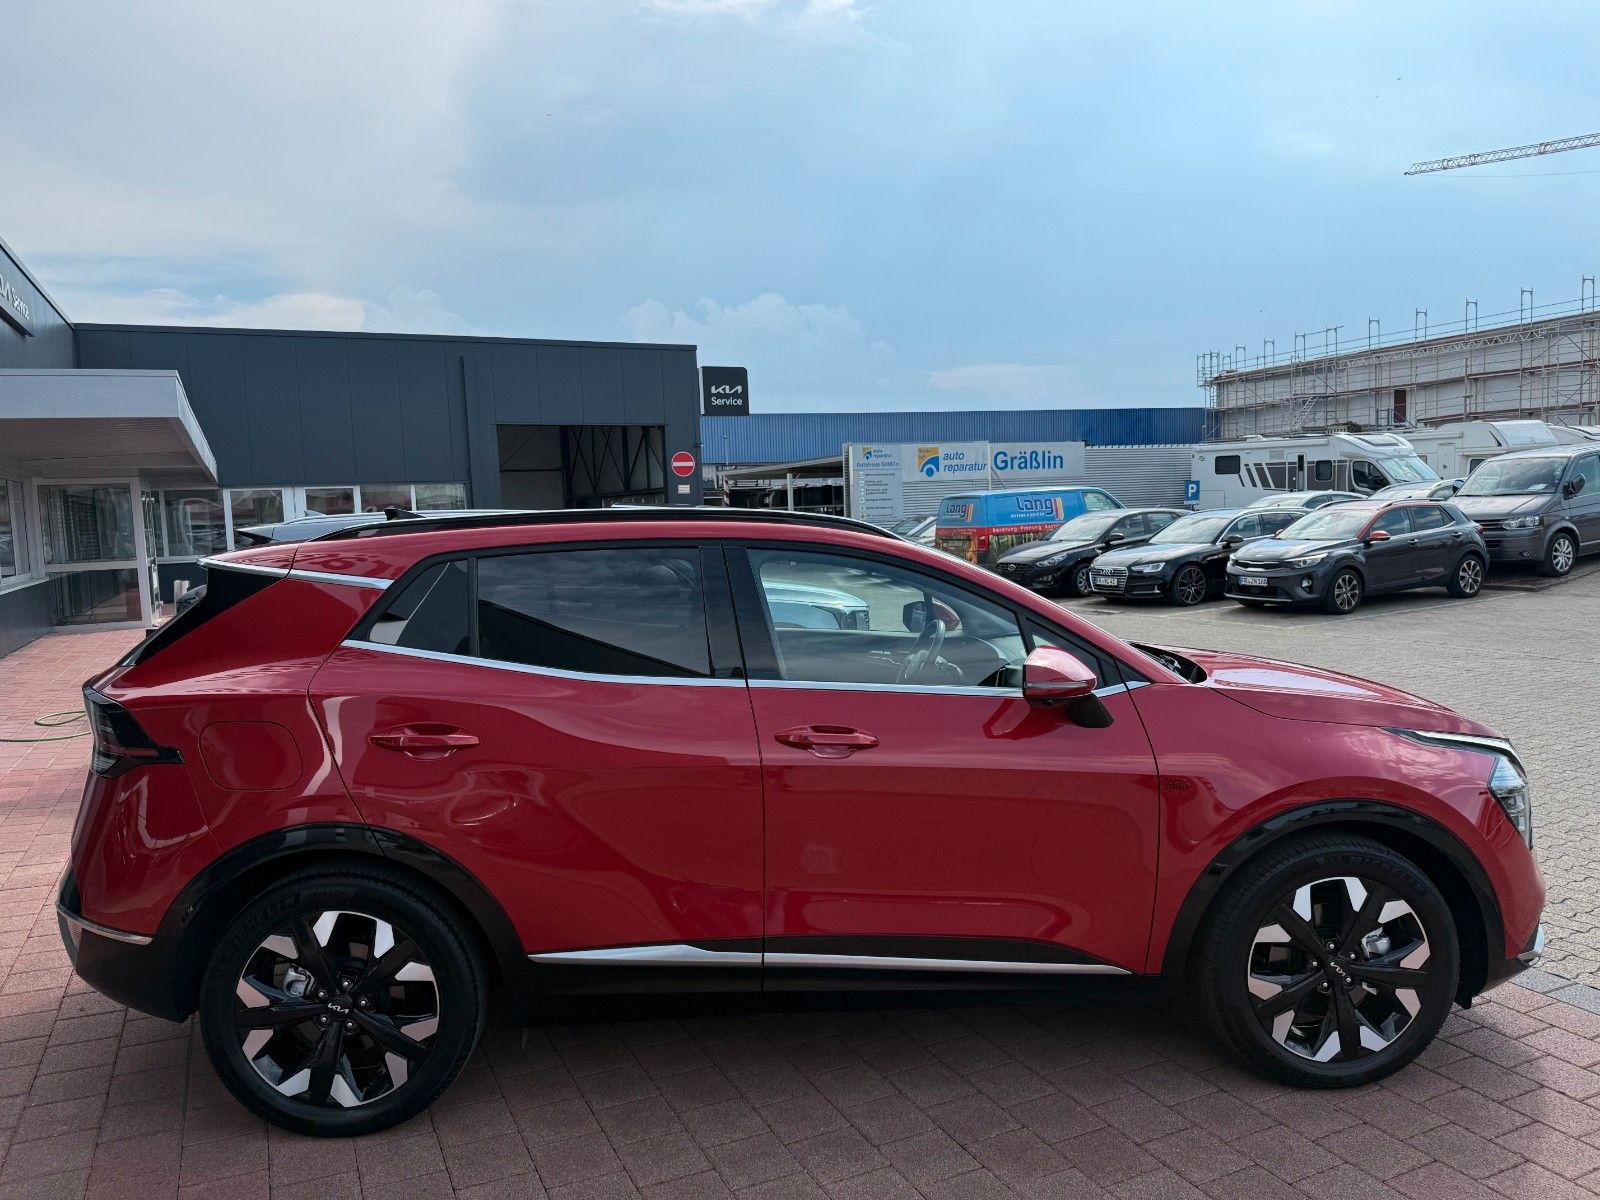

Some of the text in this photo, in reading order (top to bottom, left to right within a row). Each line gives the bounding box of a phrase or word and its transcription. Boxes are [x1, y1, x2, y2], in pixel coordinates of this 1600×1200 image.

[711, 385, 742, 394] KIA
[711, 396, 742, 406] Service
[943, 451, 965, 461] auto
[993, 450, 1064, 471] Gräßlin
[943, 462, 988, 474] reparatur
[1188, 483, 1197, 498] P
